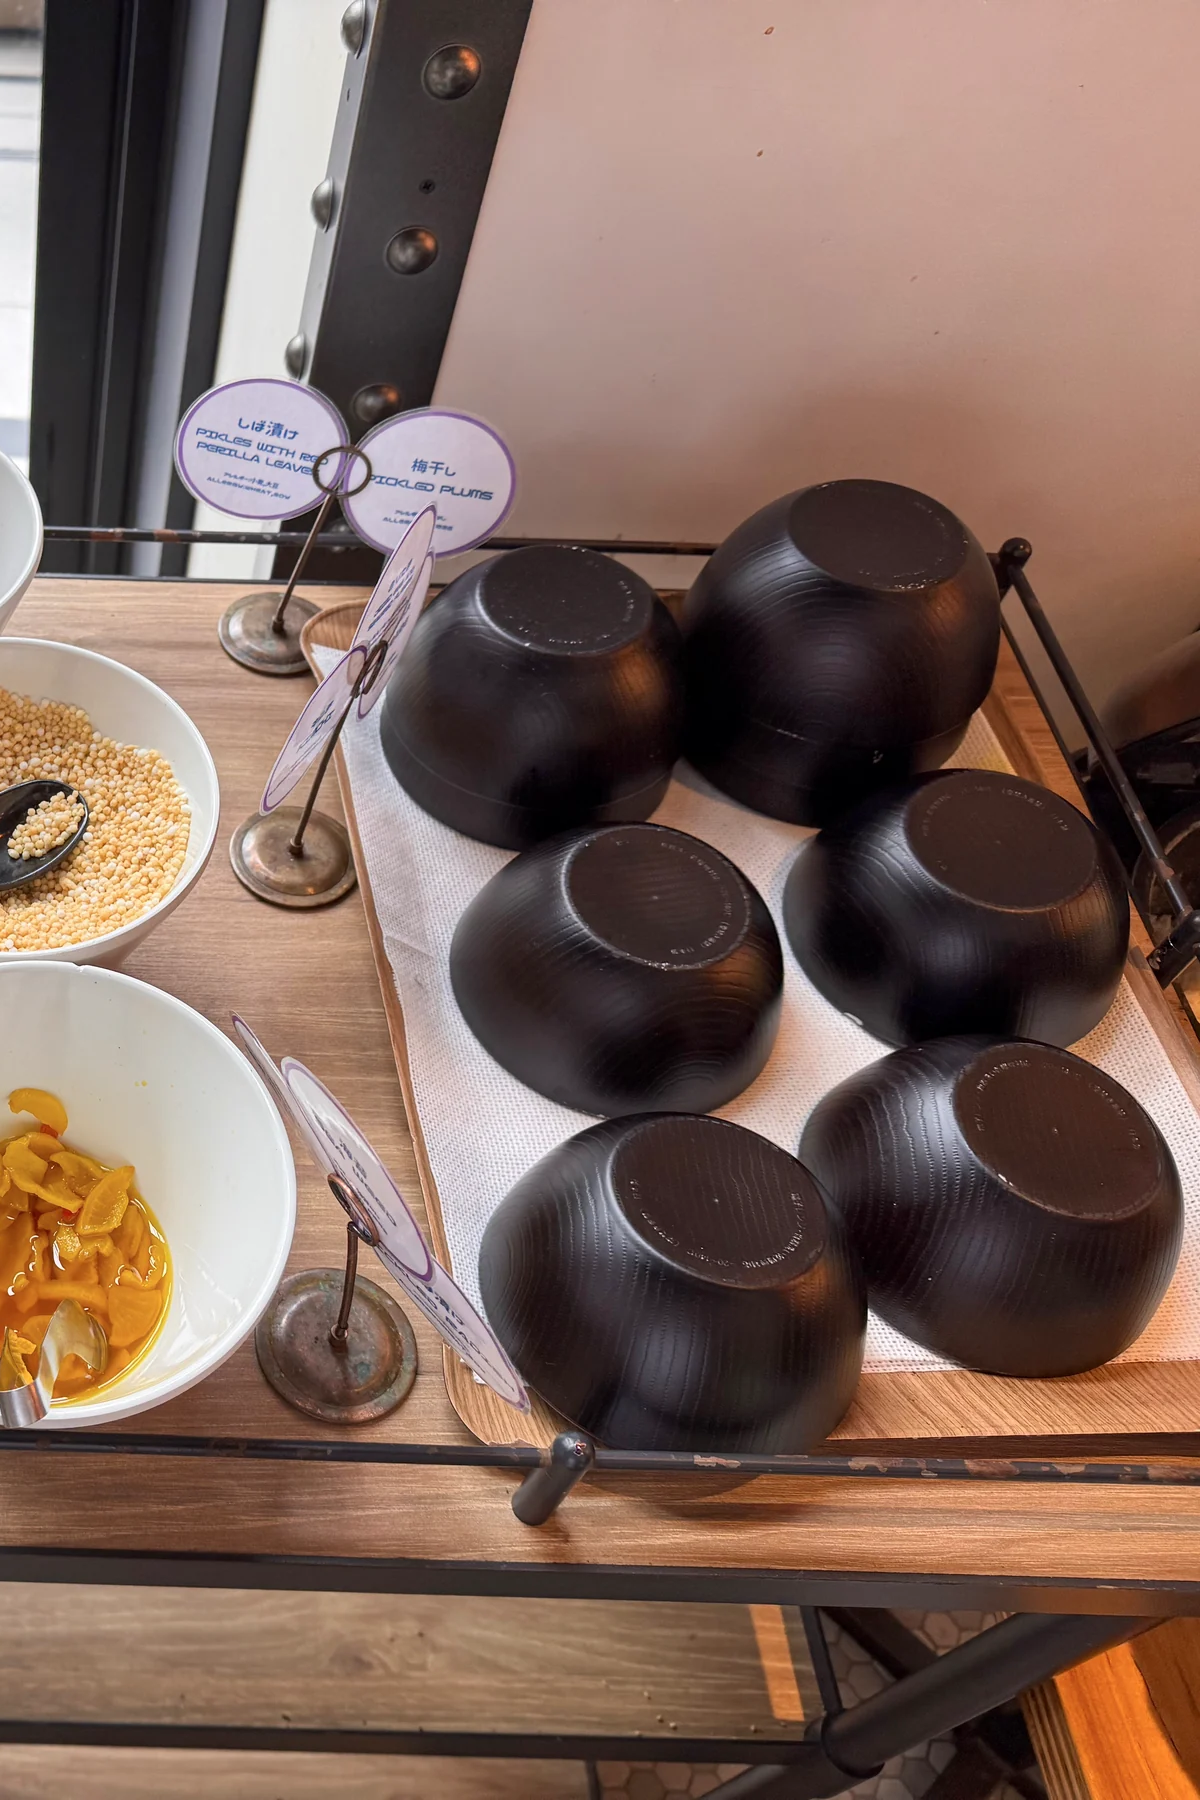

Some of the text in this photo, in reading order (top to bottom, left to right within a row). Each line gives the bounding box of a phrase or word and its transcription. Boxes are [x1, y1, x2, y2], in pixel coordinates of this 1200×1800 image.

[238, 417, 299, 440] しば漬け
[196, 428, 252, 447] PIKLES
[257, 441, 296, 458] WITH
[196, 441, 319, 476] PERILLA LEAVE
[411, 458, 456, 477] 梅干し
[440, 485, 493, 501] PLUMS
